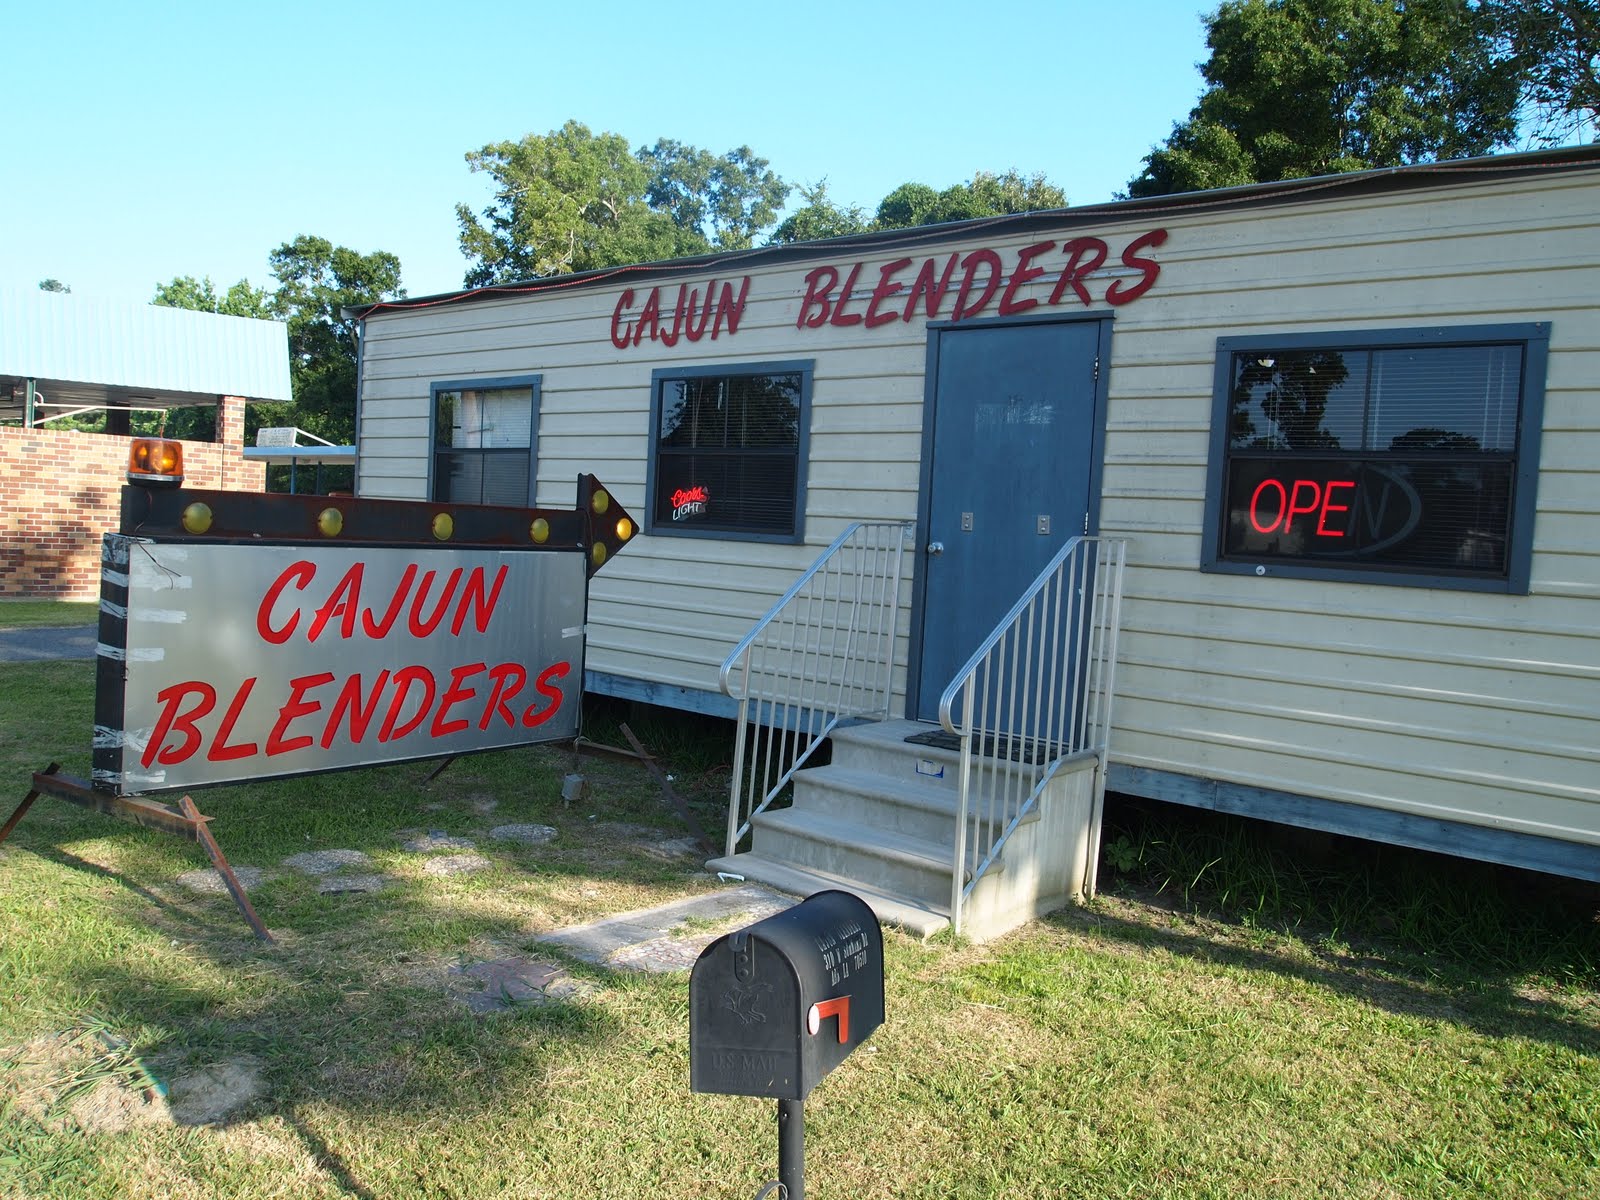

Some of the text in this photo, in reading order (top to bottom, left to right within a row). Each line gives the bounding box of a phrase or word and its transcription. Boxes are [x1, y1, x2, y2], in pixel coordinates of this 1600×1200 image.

[610, 228, 1168, 349] CAJUN BLENDERS
[671, 486, 707, 508] Coors
[672, 501, 703, 521] LIGHT
[256, 560, 509, 645] CAJUN
[140, 661, 571, 769] BLENDERS
